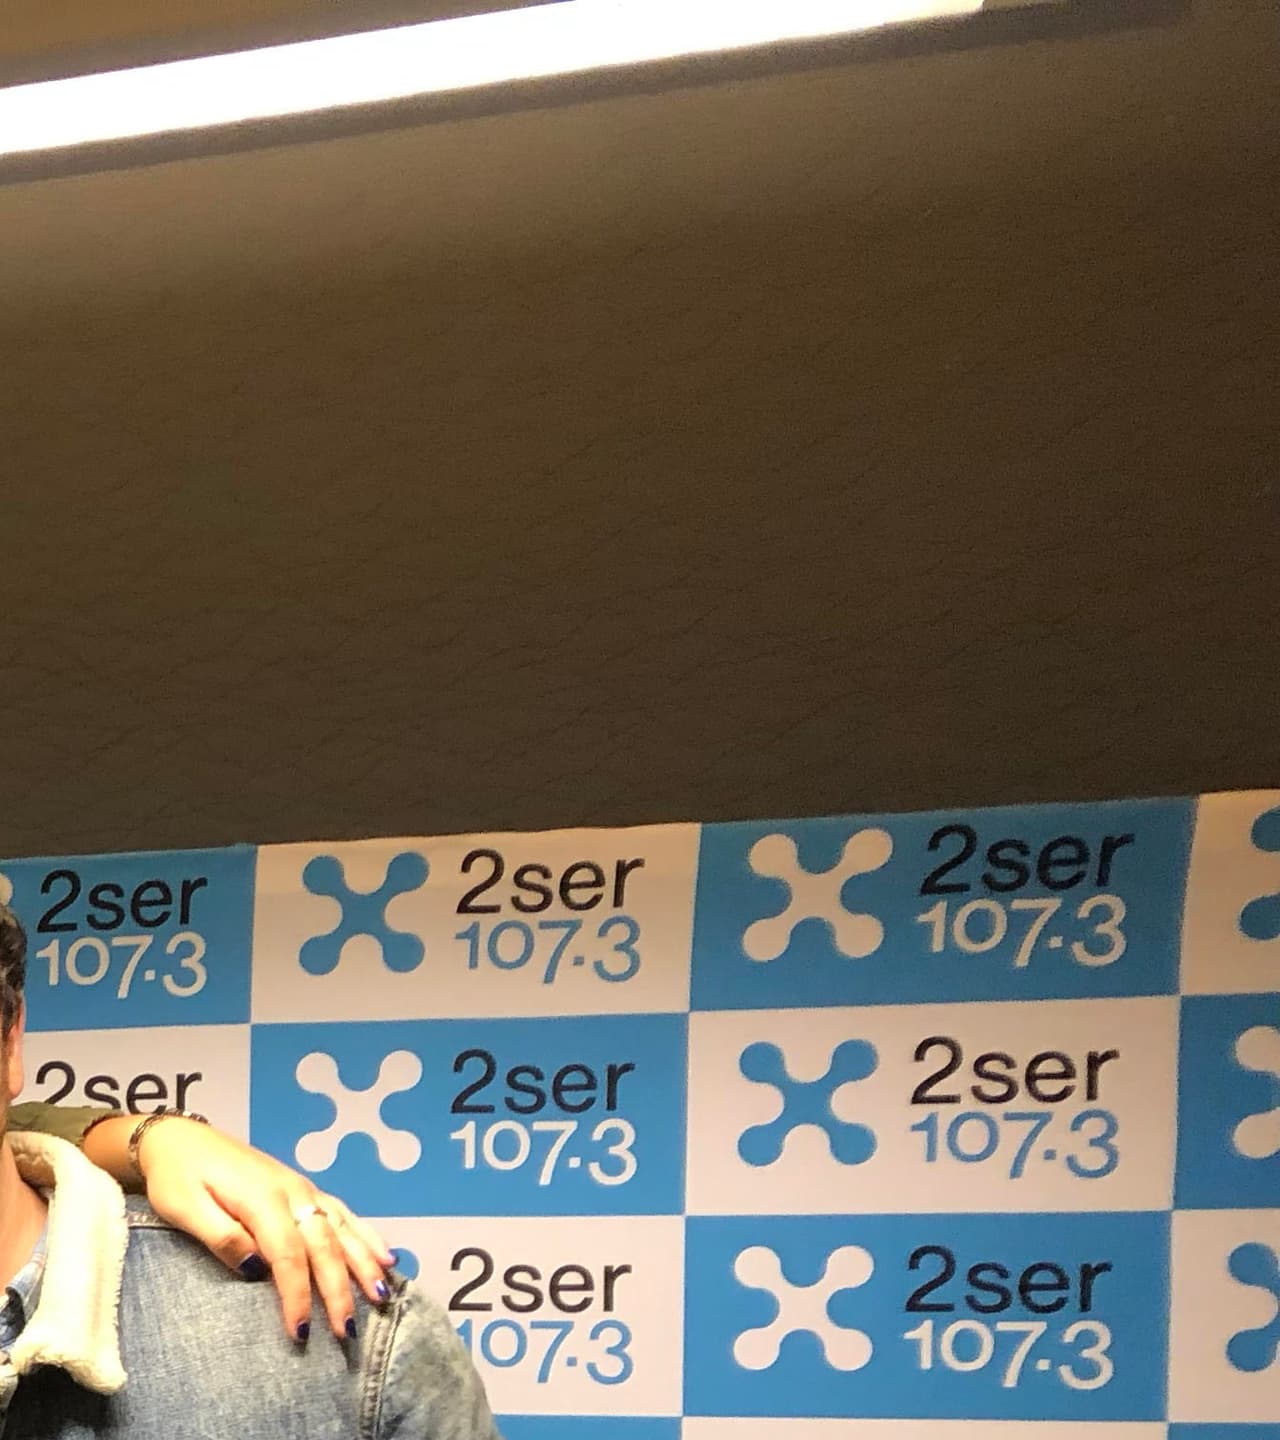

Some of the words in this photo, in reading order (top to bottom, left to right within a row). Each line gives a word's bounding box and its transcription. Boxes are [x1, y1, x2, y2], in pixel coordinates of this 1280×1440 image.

[455, 848, 645, 914] 2ser
[918, 824, 1135, 895] 2ser
[36, 869, 207, 933] 2ser
[916, 894, 1127, 969] 107.3
[36, 931, 207, 998] 107.3
[454, 915, 642, 985] 107.3
[35, 1061, 202, 1115] 2ser
[451, 1048, 636, 1114] 2ser
[910, 1036, 1120, 1105] 2ser
[450, 1117, 638, 1186] 107.3
[910, 1109, 1120, 1180] 107.3
[448, 1247, 632, 1313] 2ser
[904, 1245, 1112, 1314] 2ser
[902, 1319, 1114, 1390] 107.3
